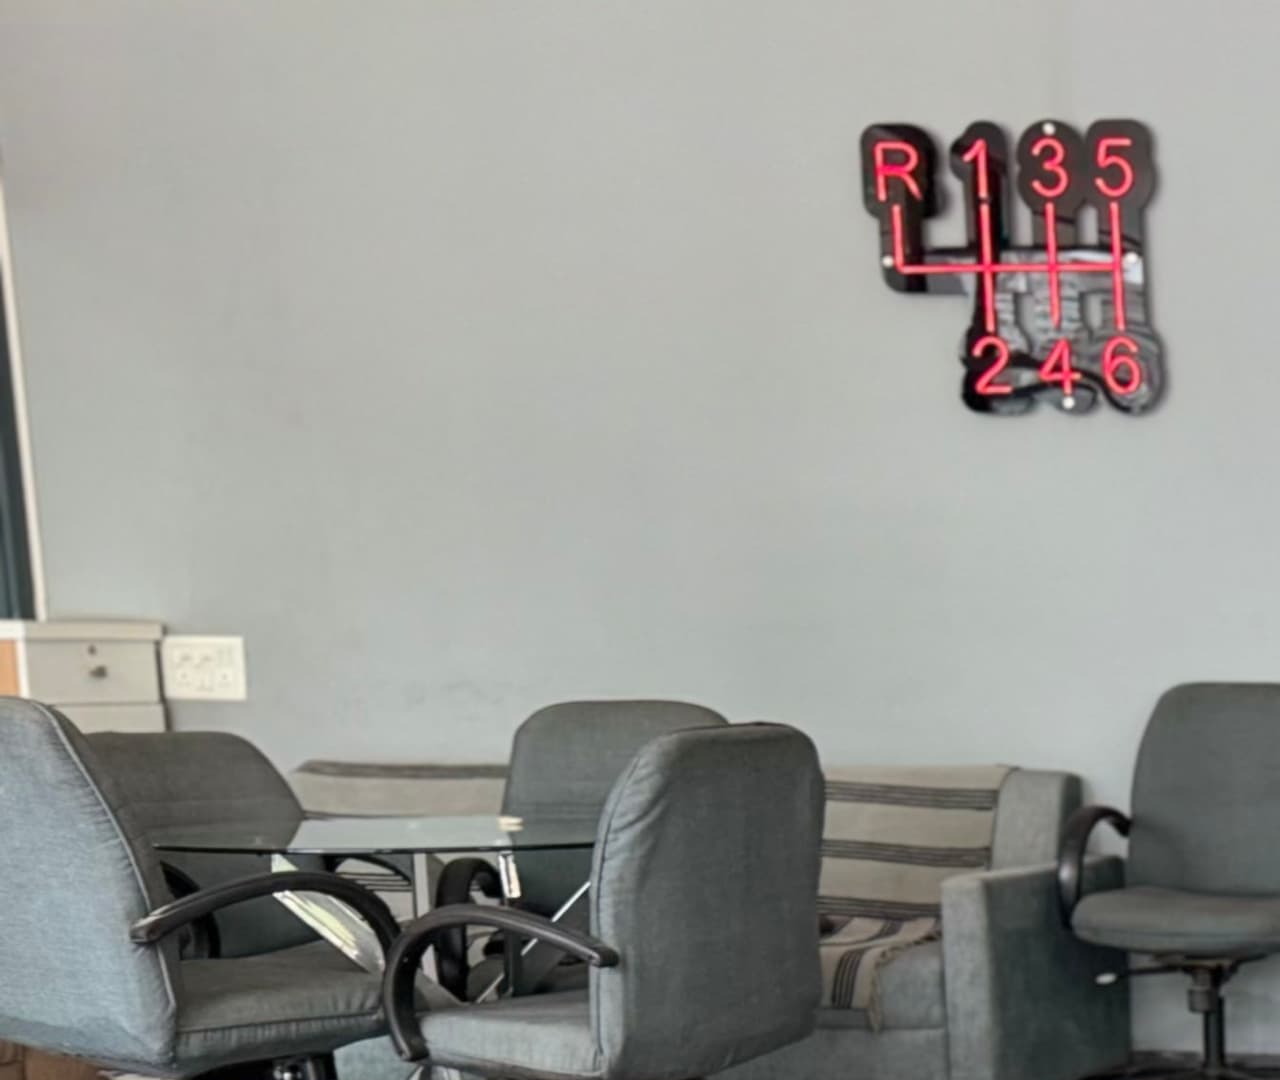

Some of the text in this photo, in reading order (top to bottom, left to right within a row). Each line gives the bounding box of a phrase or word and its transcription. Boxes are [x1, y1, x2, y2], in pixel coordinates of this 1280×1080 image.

[873, 137, 1134, 202] R 1 3 5
[972, 336, 1142, 395] 2 4 6
